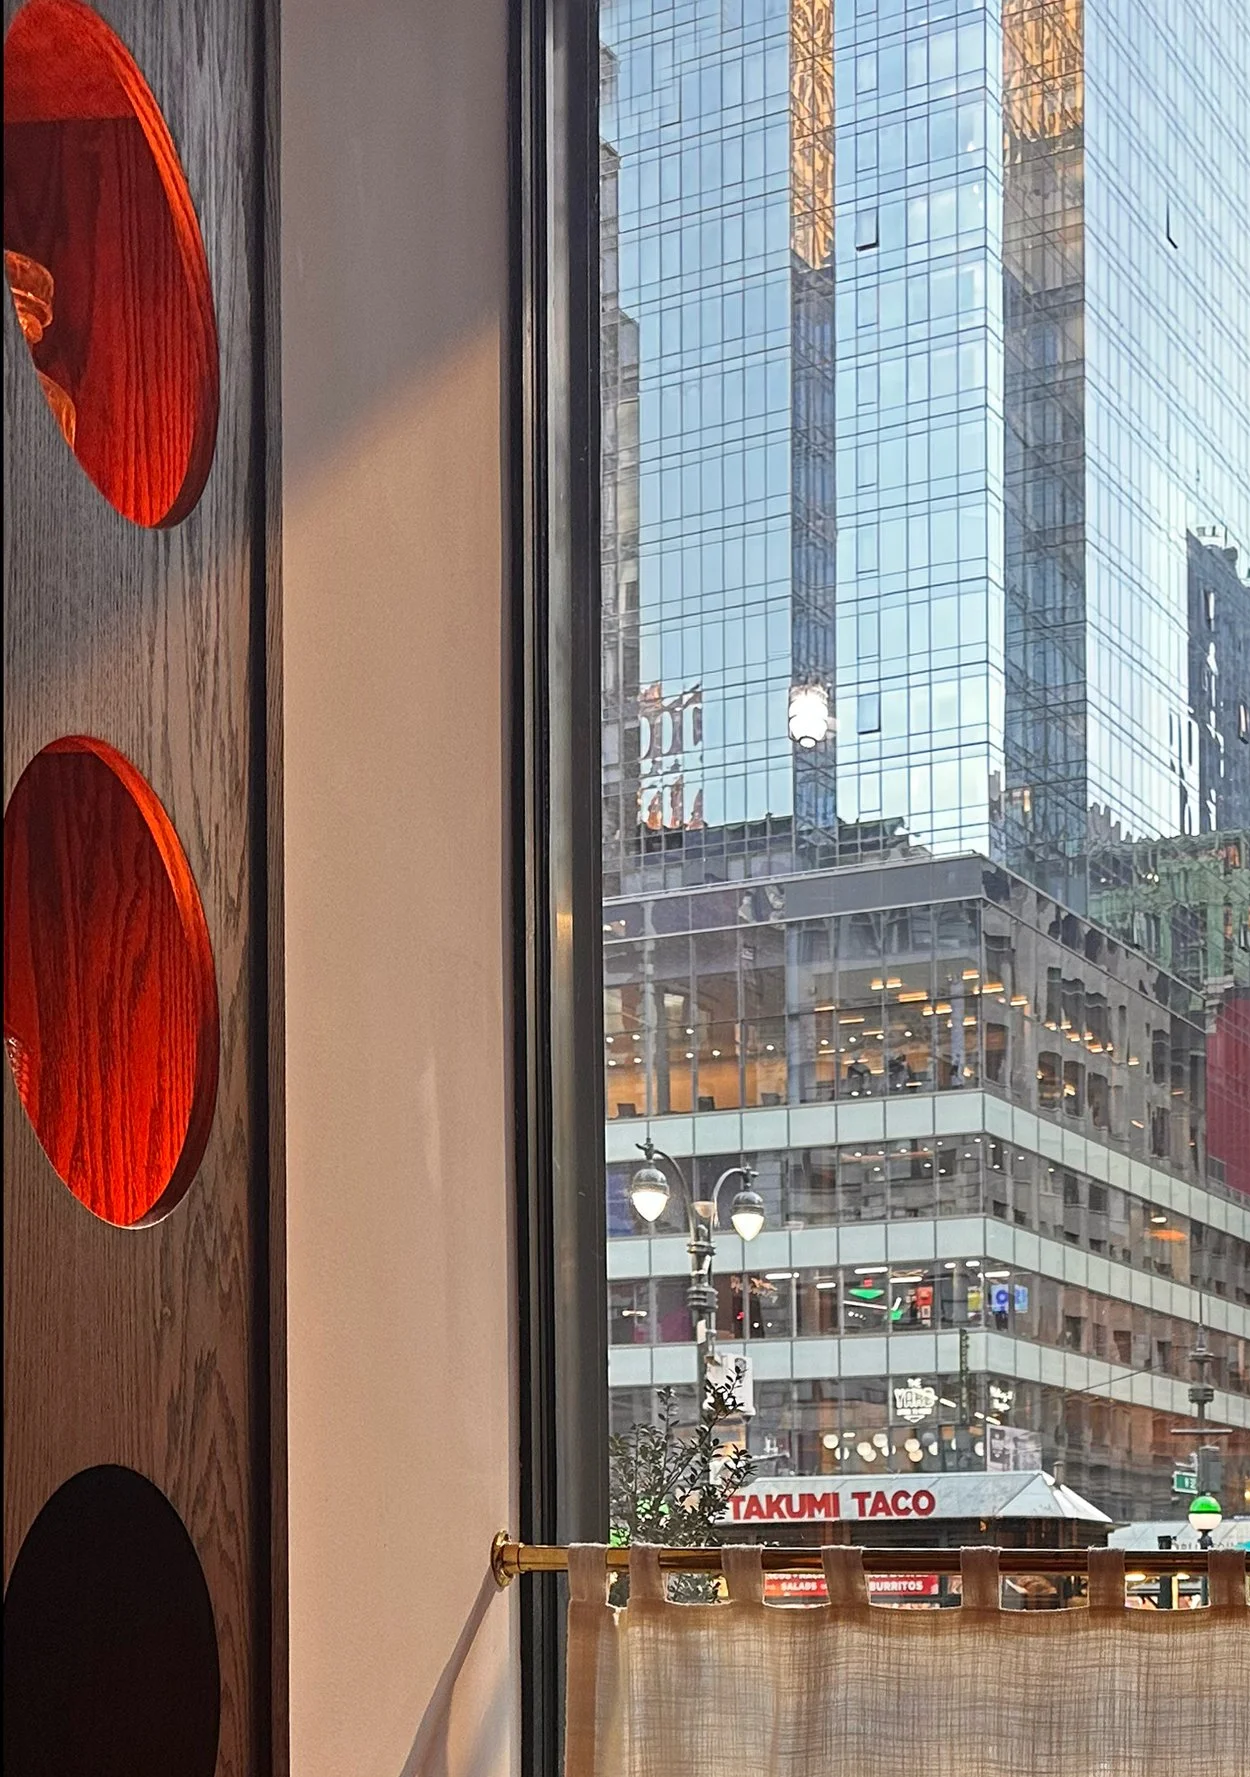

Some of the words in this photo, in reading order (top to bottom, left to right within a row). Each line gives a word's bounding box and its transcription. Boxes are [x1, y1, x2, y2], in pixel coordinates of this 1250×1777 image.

[730, 1492, 840, 1520] TAKUMI
[851, 1489, 936, 1518] TACO
[868, 1580, 924, 1592] BURRITOS
